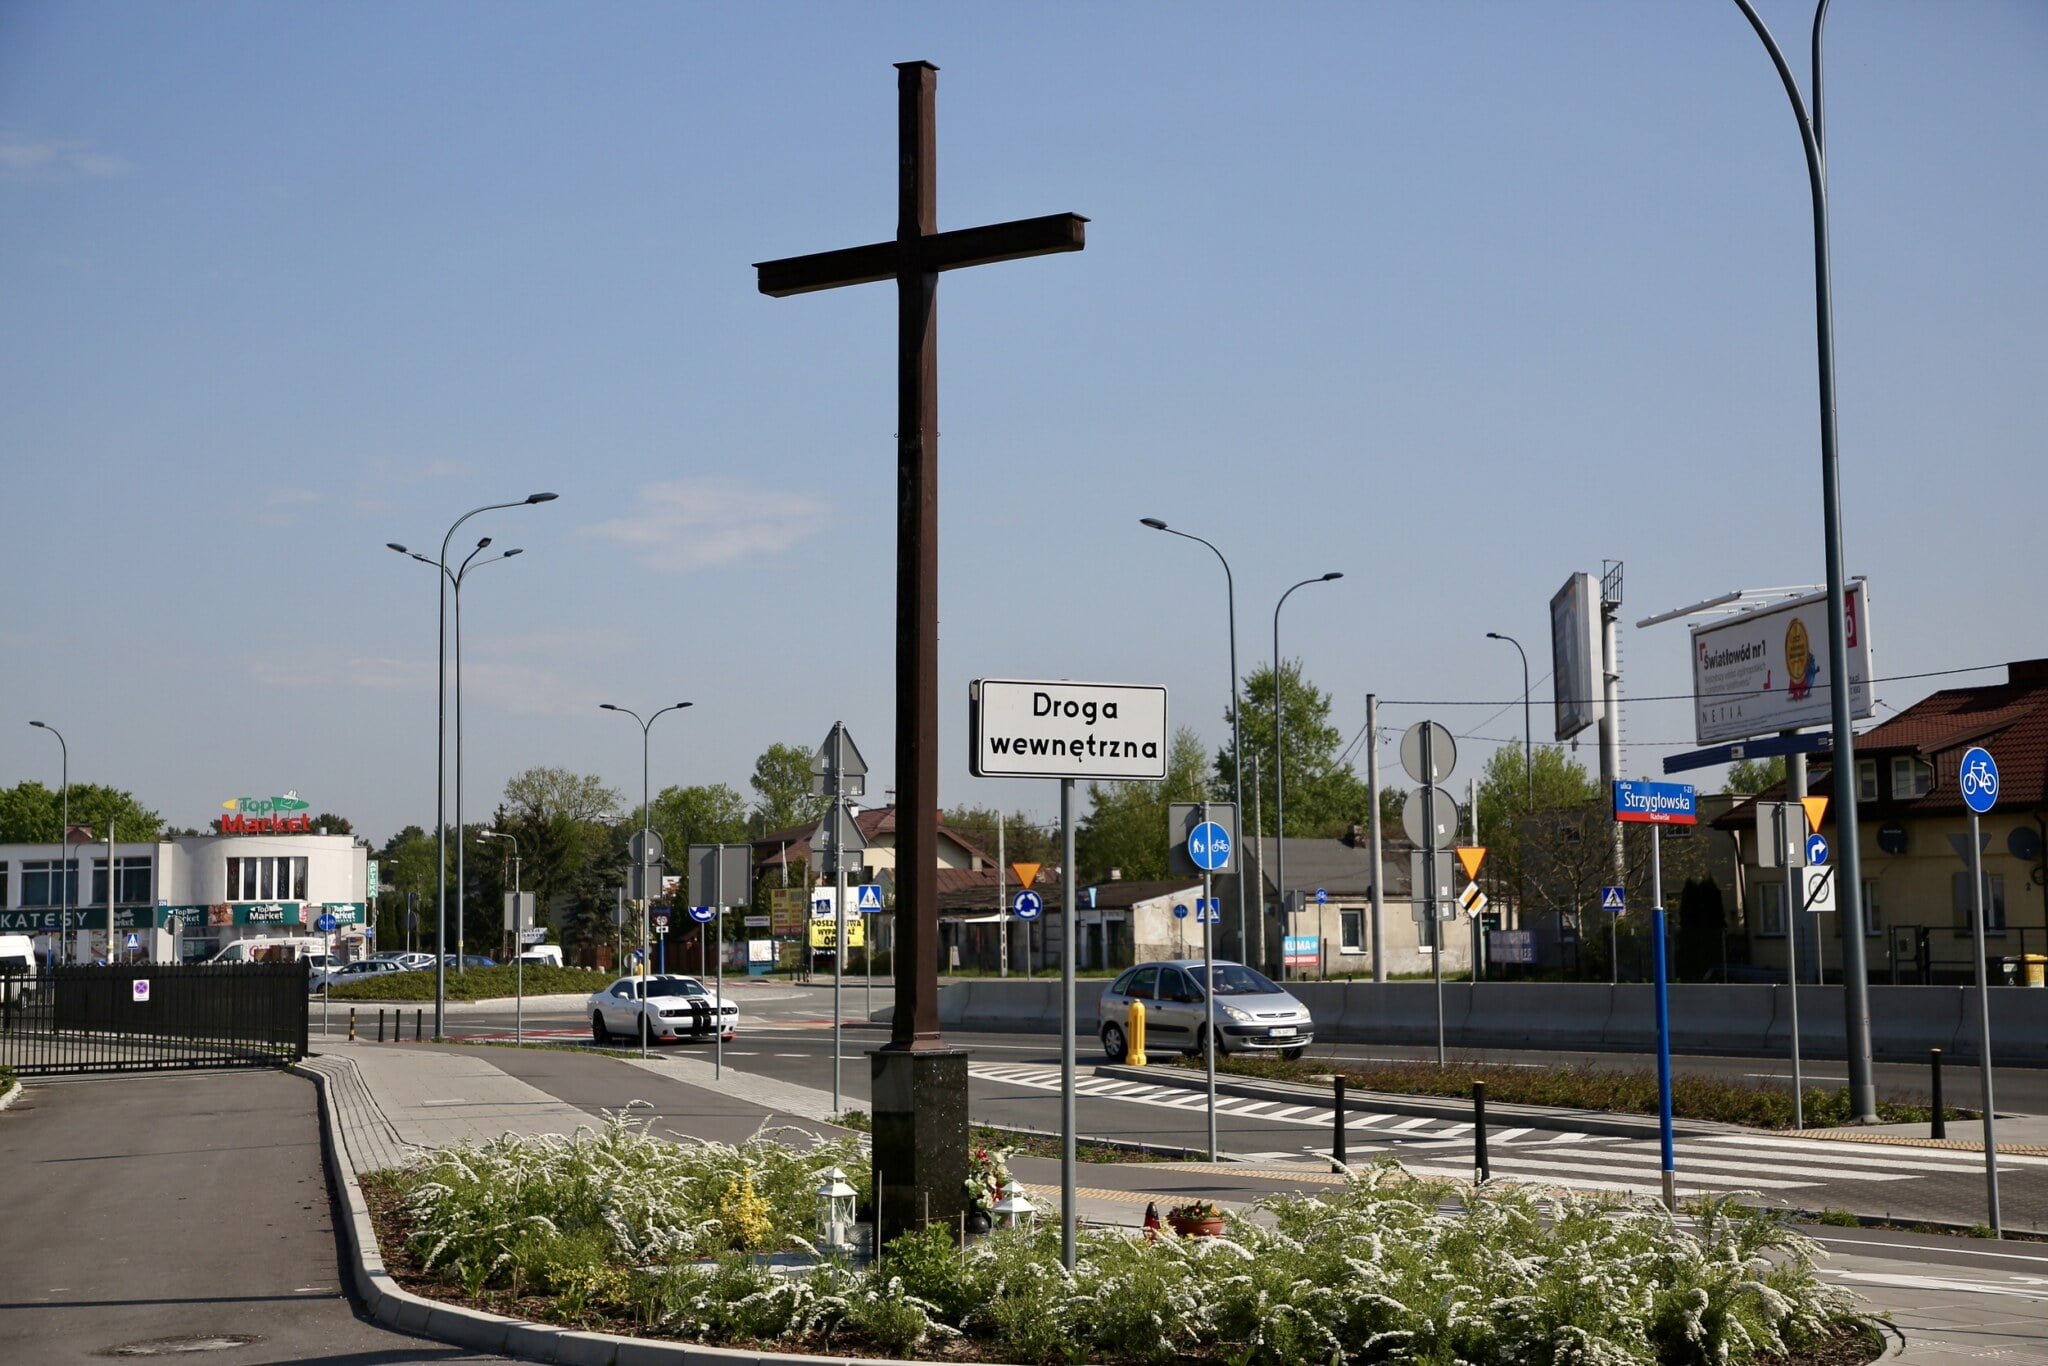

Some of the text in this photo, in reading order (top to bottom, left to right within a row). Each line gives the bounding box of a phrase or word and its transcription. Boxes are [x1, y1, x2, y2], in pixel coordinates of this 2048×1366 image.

[1703, 643, 1750, 670] Światłowód
[1033, 692, 1118, 725] Droga
[1702, 704, 1742, 723] NETIA
[990, 733, 1157, 763] wewnętrzna
[1620, 782, 1632, 790] ulica
[238, 797, 273, 815] Top
[1624, 791, 1690, 812] Strzygłowska
[221, 813, 310, 833] Market
[369, 861, 377, 896] APTEKA
[249, 911, 284, 921] Market
[257, 905, 269, 914] Top
